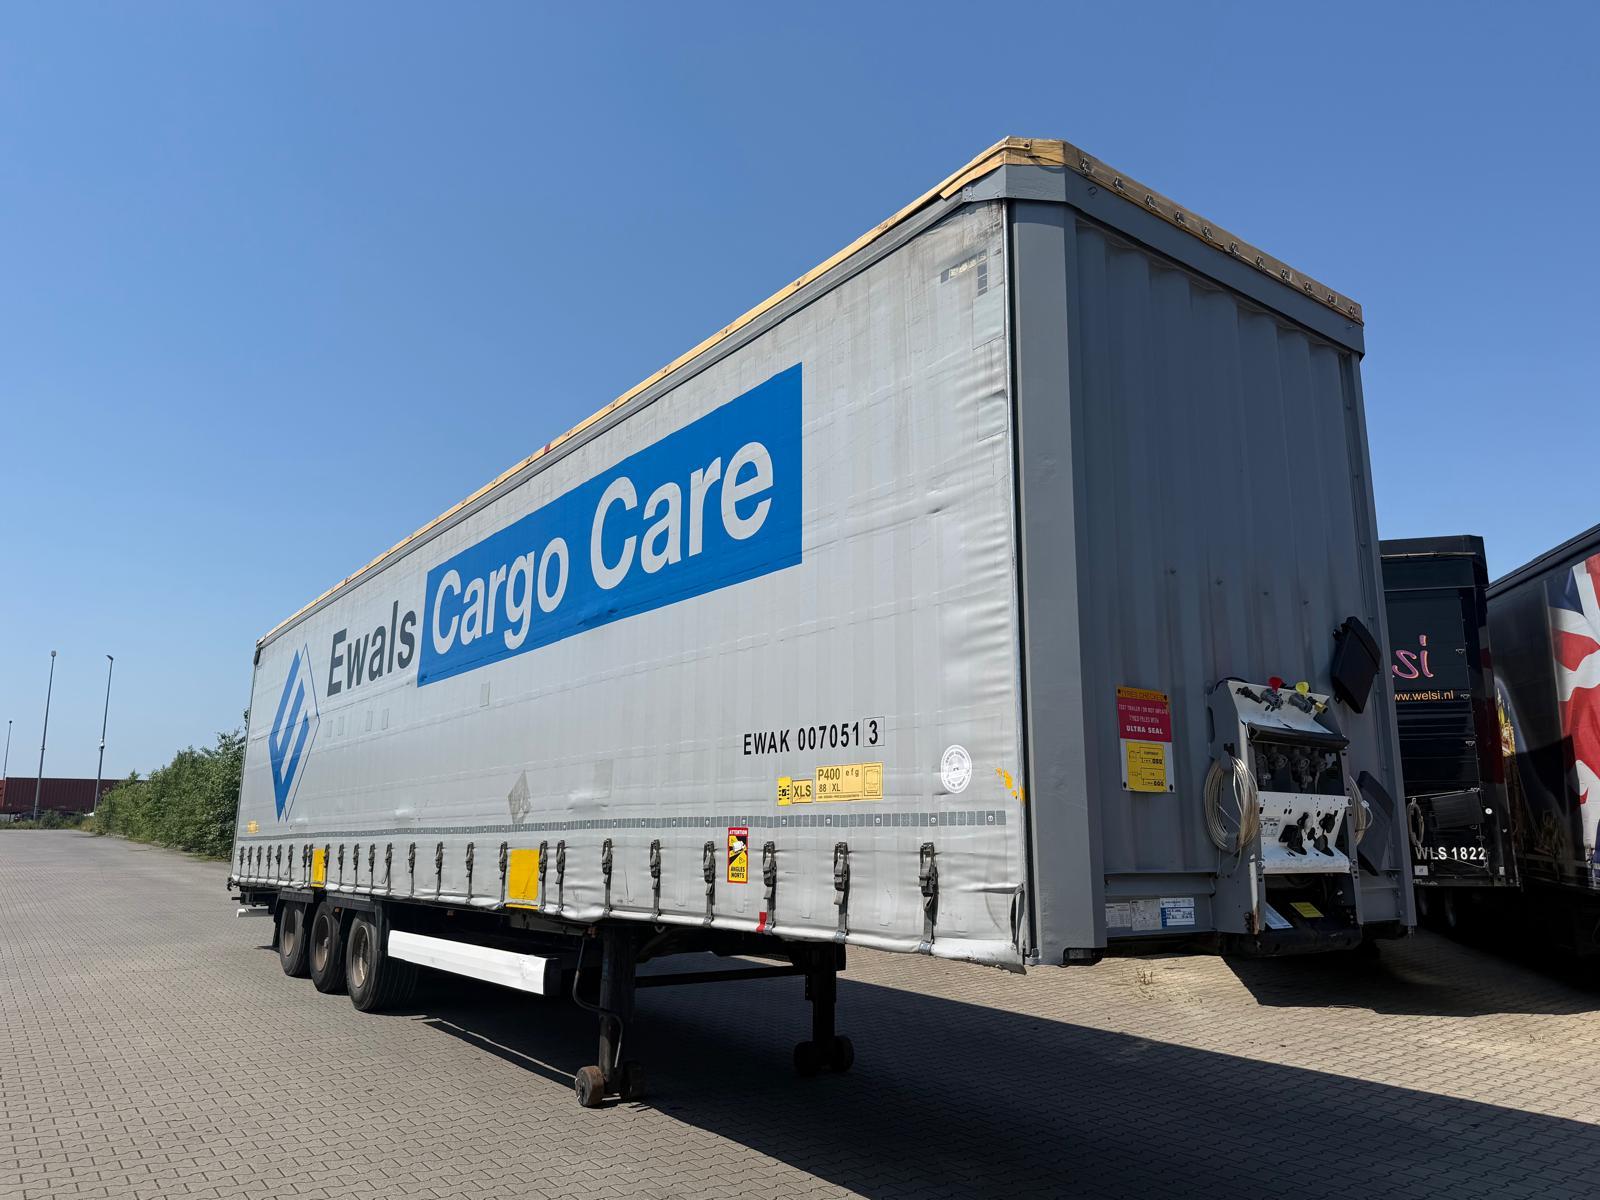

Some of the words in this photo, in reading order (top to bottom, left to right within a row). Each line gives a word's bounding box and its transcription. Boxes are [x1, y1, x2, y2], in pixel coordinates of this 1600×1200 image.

[327, 600, 417, 698] Ewals
[431, 537, 570, 655] Cargo
[590, 441, 774, 590] Care
[1392, 634, 1434, 679] si
[1126, 725, 1146, 733] ULTRA
[1147, 727, 1163, 735] SEAL
[743, 729, 790, 755] EWAK
[797, 721, 859, 751] 007051
[868, 720, 878, 744] 3
[817, 768, 841, 781] P400
[793, 784, 812, 798] XLS
[831, 783, 841, 792] XL
[1415, 846, 1447, 860] WLS
[1450, 846, 1487, 860] 1822
